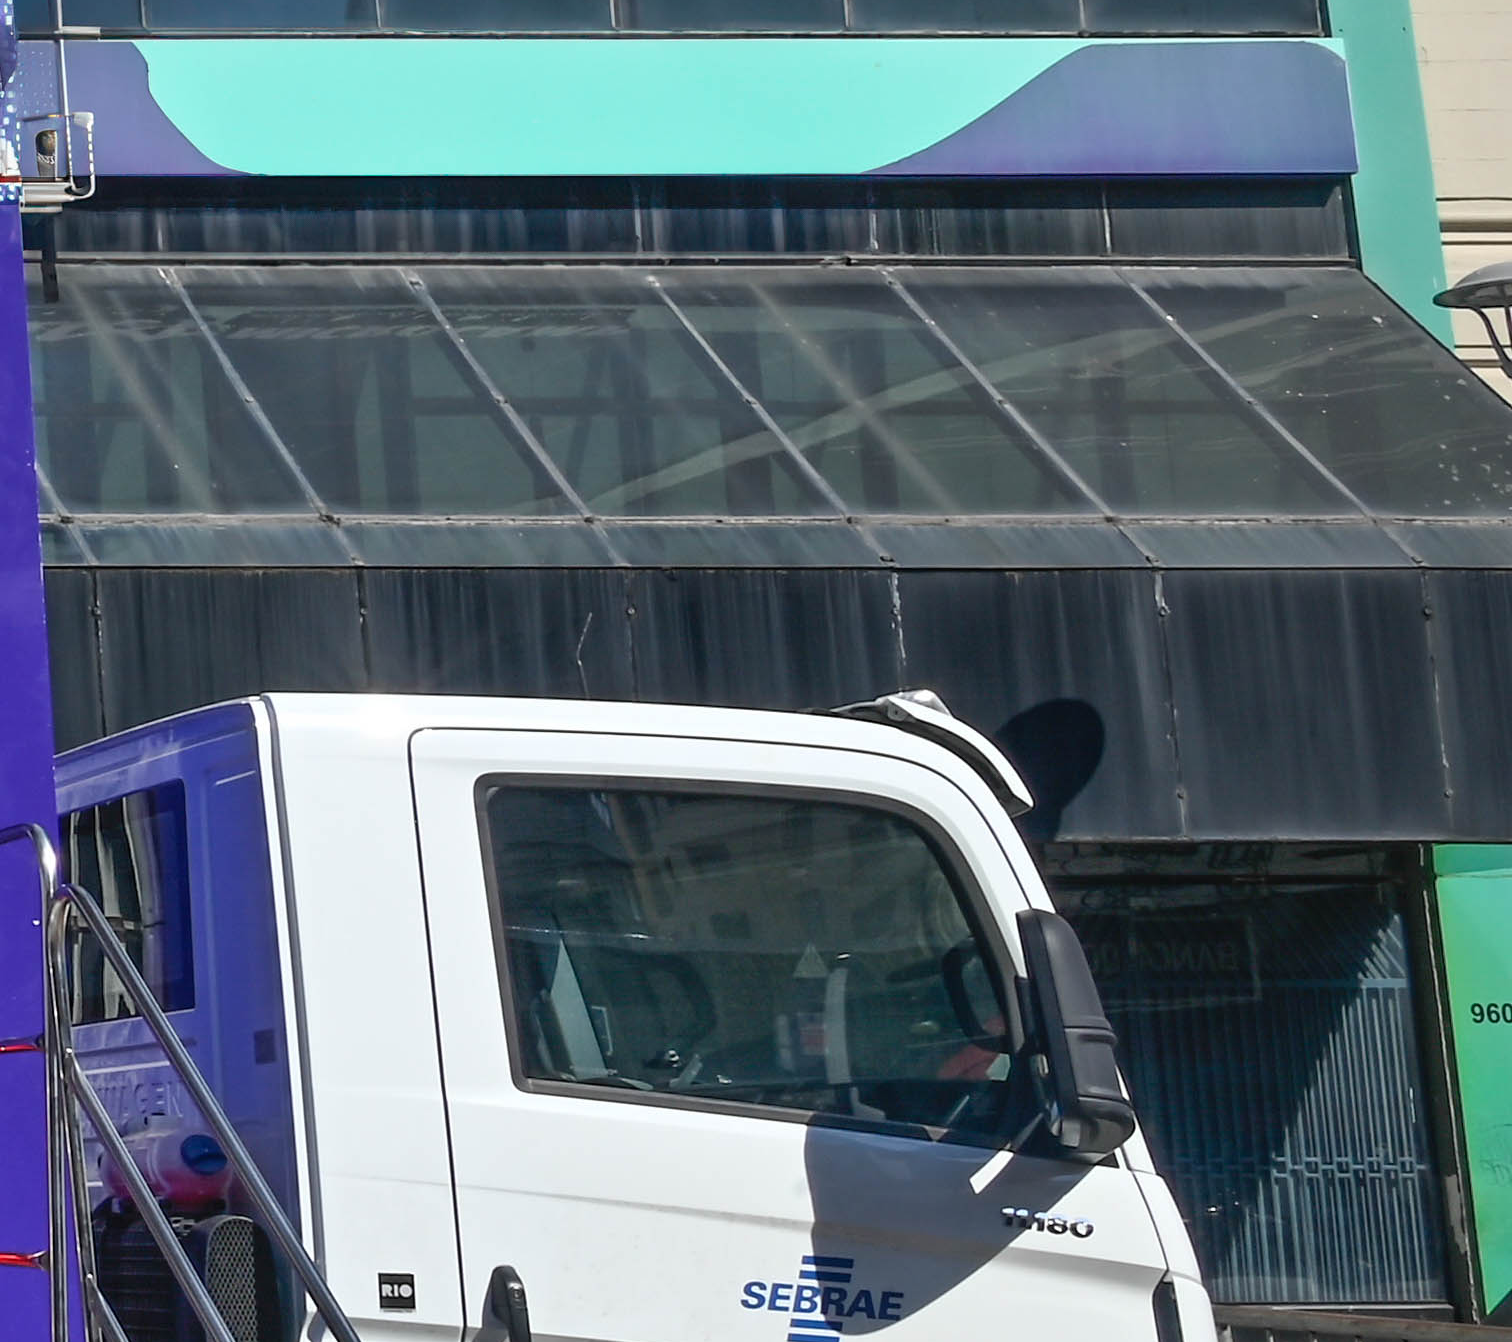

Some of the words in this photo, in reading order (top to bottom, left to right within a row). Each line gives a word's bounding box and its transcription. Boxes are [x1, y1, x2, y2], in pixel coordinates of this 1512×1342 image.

[1470, 1002, 1512, 1024] 960
[381, 1284, 413, 1298] RIO
[740, 1281, 904, 1322] SEBRAE
